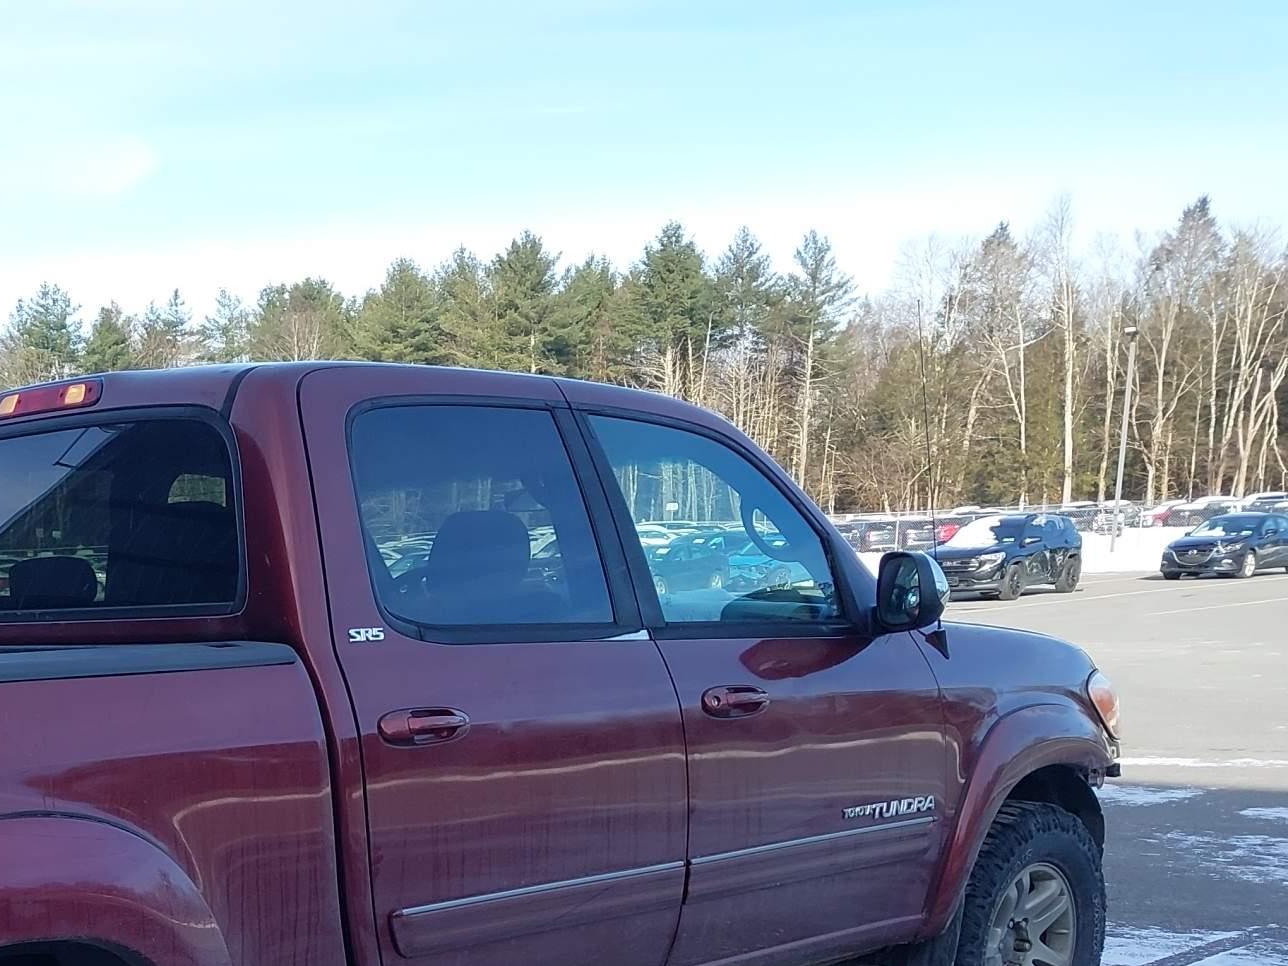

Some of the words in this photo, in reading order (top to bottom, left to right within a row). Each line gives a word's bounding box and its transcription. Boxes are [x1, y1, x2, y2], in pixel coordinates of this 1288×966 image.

[348, 627, 385, 642] SR5
[842, 804, 873, 819] TOYOTA
[872, 795, 935, 819] TUNDRA
